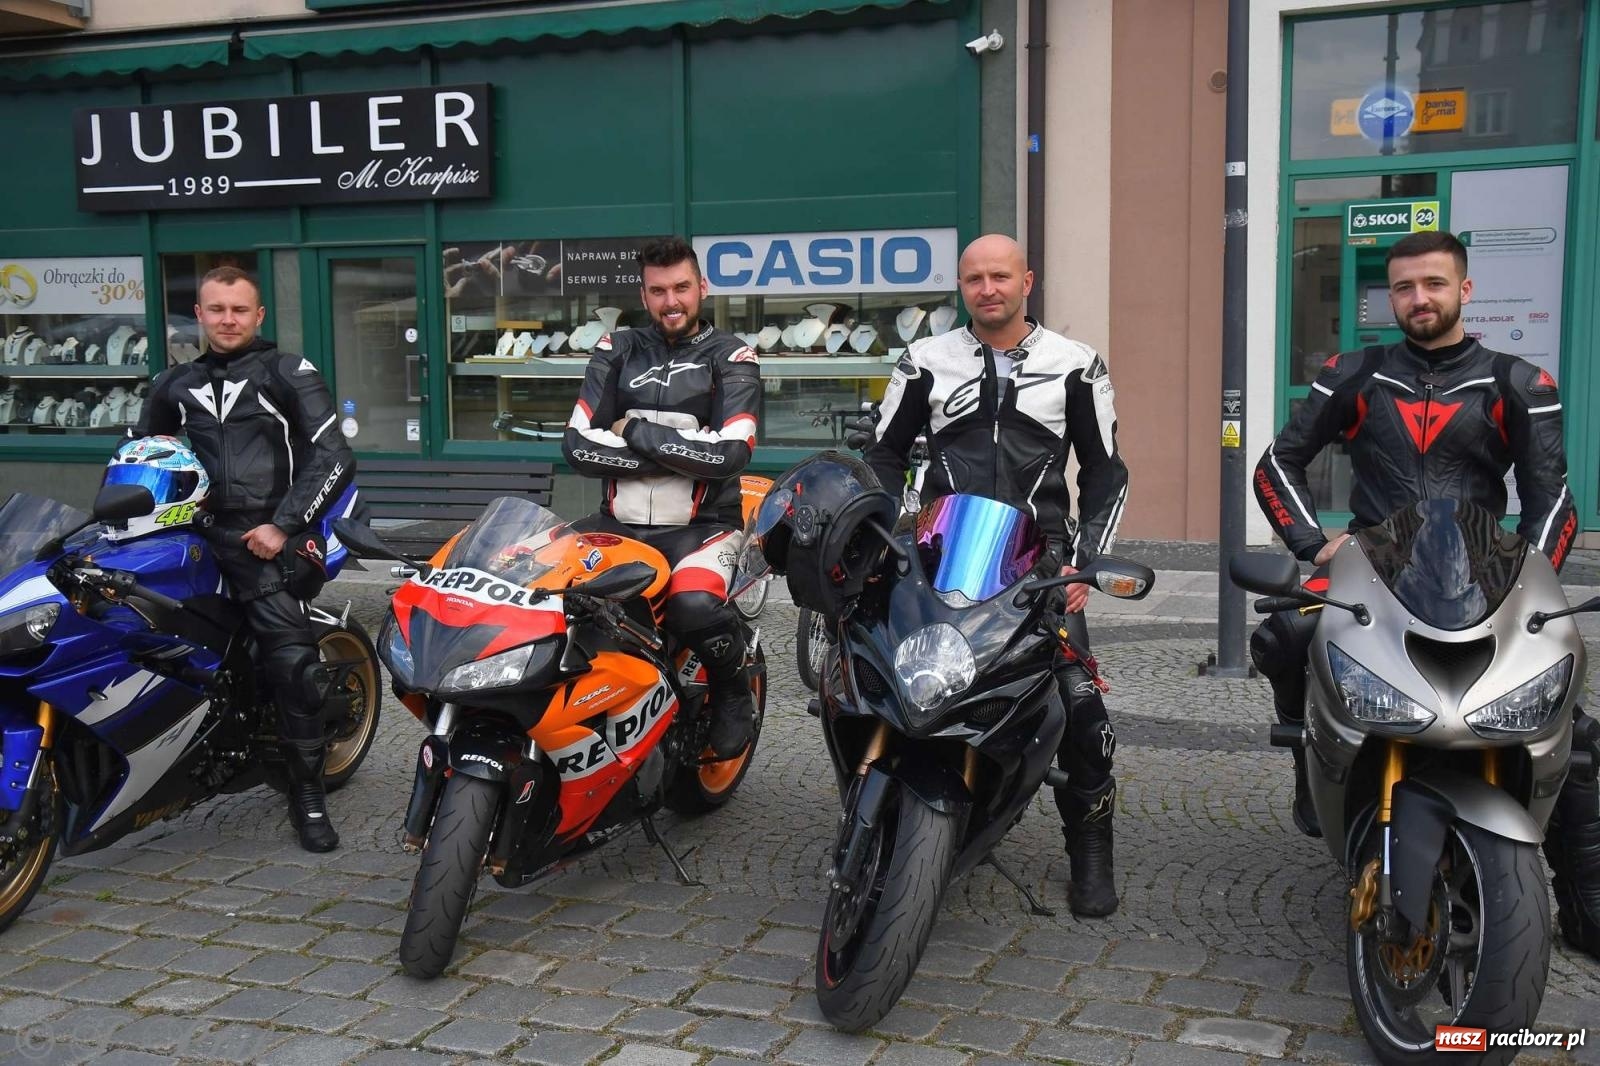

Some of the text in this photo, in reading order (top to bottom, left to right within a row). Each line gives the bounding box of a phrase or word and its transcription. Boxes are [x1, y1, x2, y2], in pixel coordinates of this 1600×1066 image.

[81, 92, 479, 165] JUBILER
[168, 175, 231, 196] 1989
[338, 156, 480, 195] M. Karpisz
[1368, 211, 1433, 226] SKOK 24
[567, 249, 641, 261] NAPRAWA BIŻ
[706, 236, 932, 287] CASIO
[43, 267, 126, 288] Obrączki do
[567, 275, 608, 284] SERWIS
[91, 279, 144, 305] -30%
[572, 449, 640, 469] alpinestars
[659, 443, 725, 465] alpinestars
[303, 462, 344, 523] DAINESE
[154, 501, 197, 527] 46
[424, 571, 527, 606] REPSOL
[445, 597, 474, 608] HONDA
[460, 753, 505, 772] REPSOL
